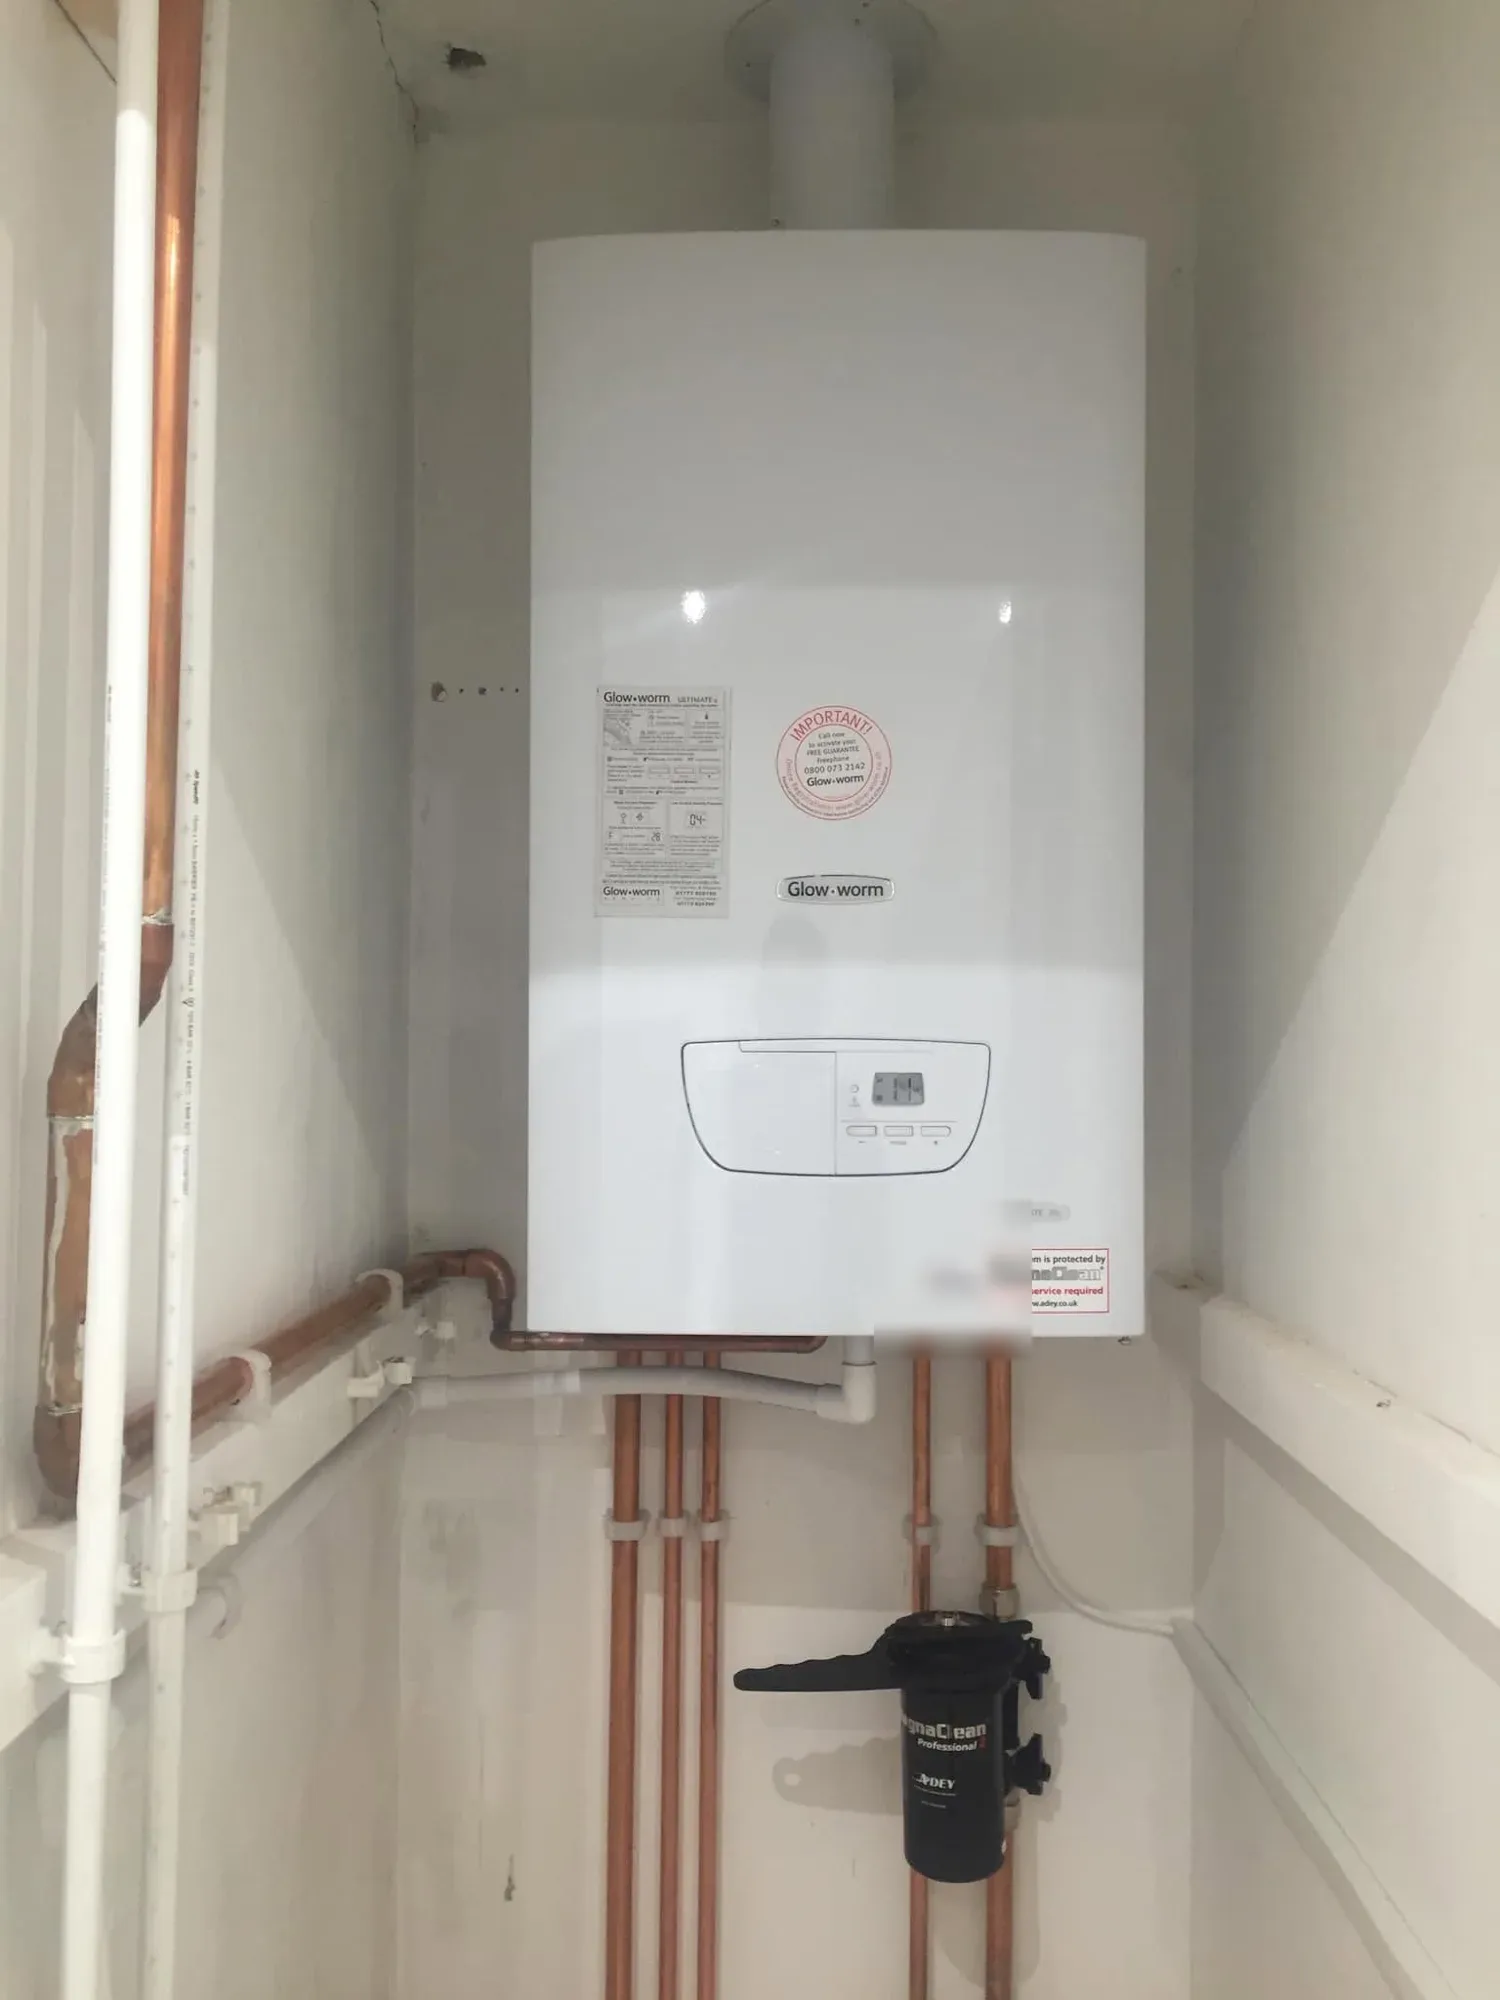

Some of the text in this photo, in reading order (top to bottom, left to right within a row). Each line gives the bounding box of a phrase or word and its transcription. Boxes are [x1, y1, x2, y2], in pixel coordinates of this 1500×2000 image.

[790, 710, 873, 741] IMPORTANT!
[823, 745, 860, 755] GUARANTEE
[804, 762, 865, 774] 0800 073 2142
[1044, 1255, 1051, 1263] is
[1053, 1255, 1093, 1264] protected
[1095, 1255, 1106, 1264] by
[1064, 1286, 1104, 1296] required
[1032, 1300, 1078, 1308] w.adey.co.uk
[917, 1738, 977, 1752] Professional
